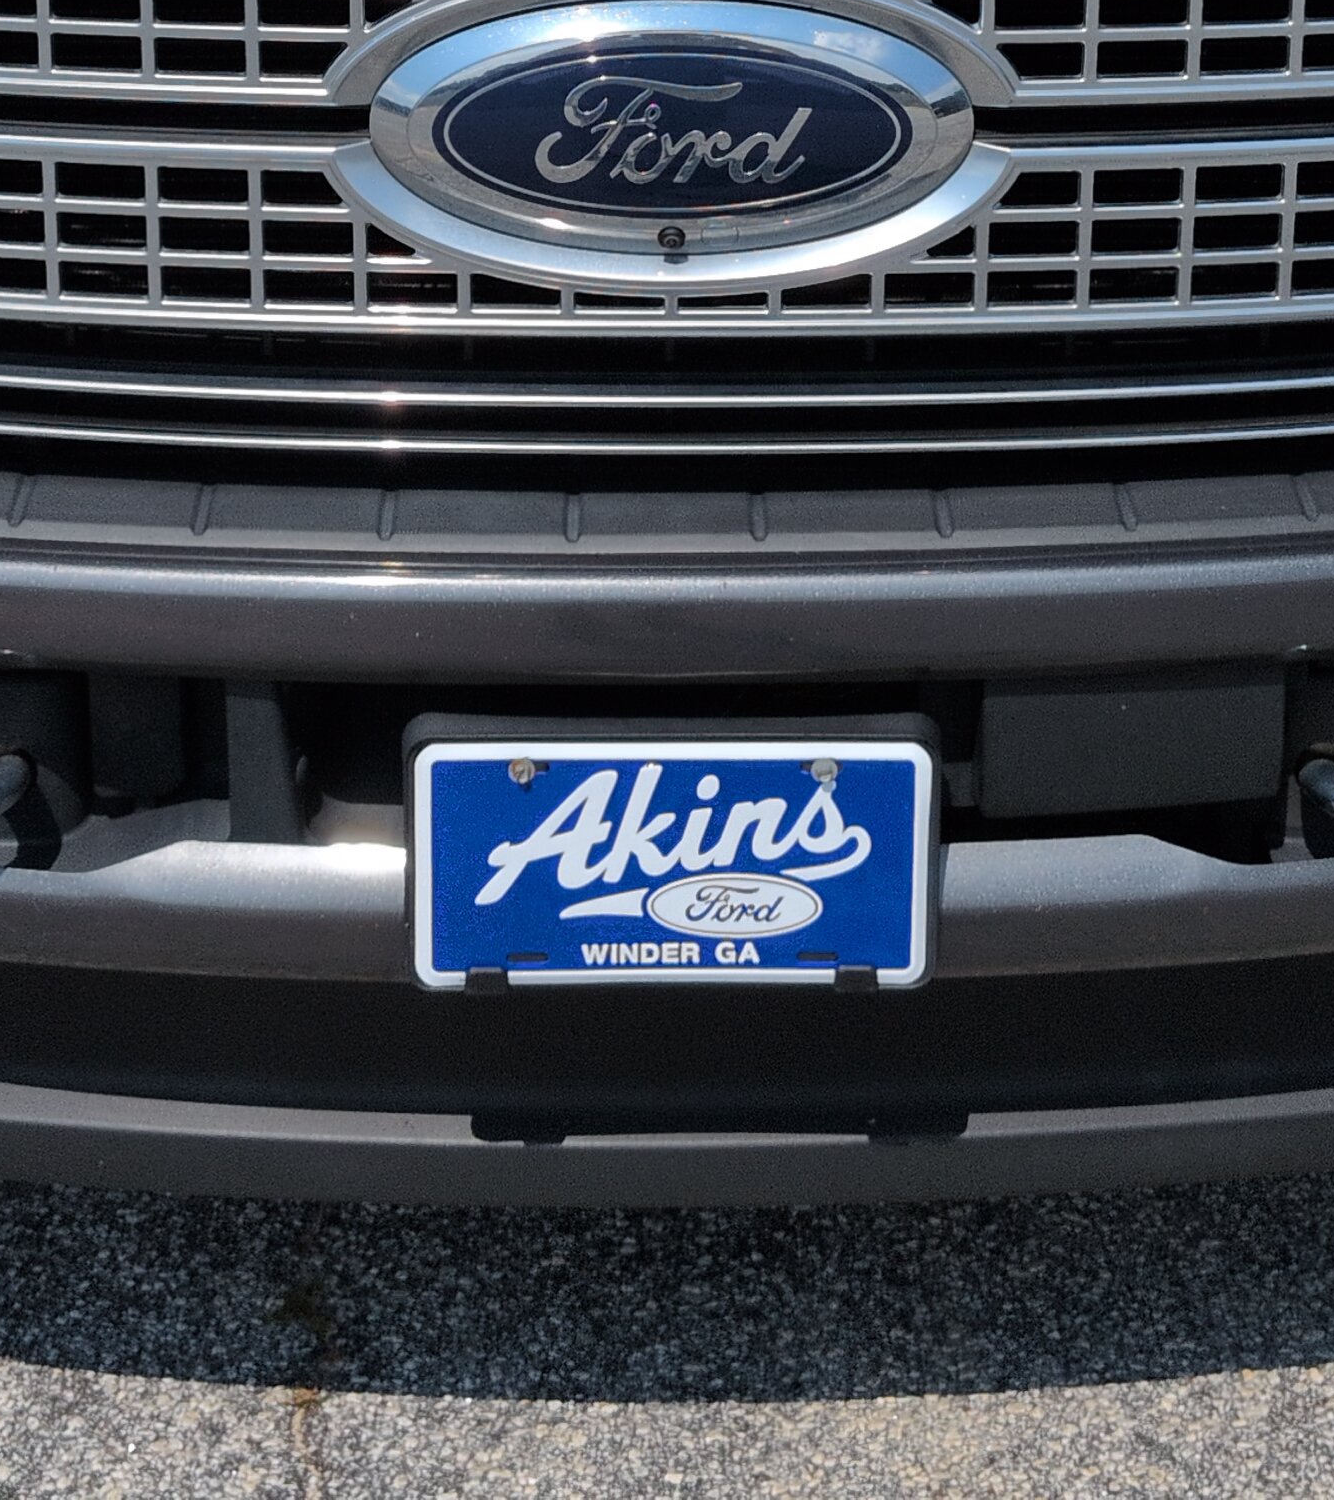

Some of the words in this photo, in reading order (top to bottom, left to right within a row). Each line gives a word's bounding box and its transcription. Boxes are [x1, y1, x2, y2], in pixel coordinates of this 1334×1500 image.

[533, 75, 813, 185] Ford
[474, 763, 872, 906] Akins
[684, 883, 784, 924] Ford
[580, 942, 701, 967] WINDER
[714, 942, 761, 966] GA
